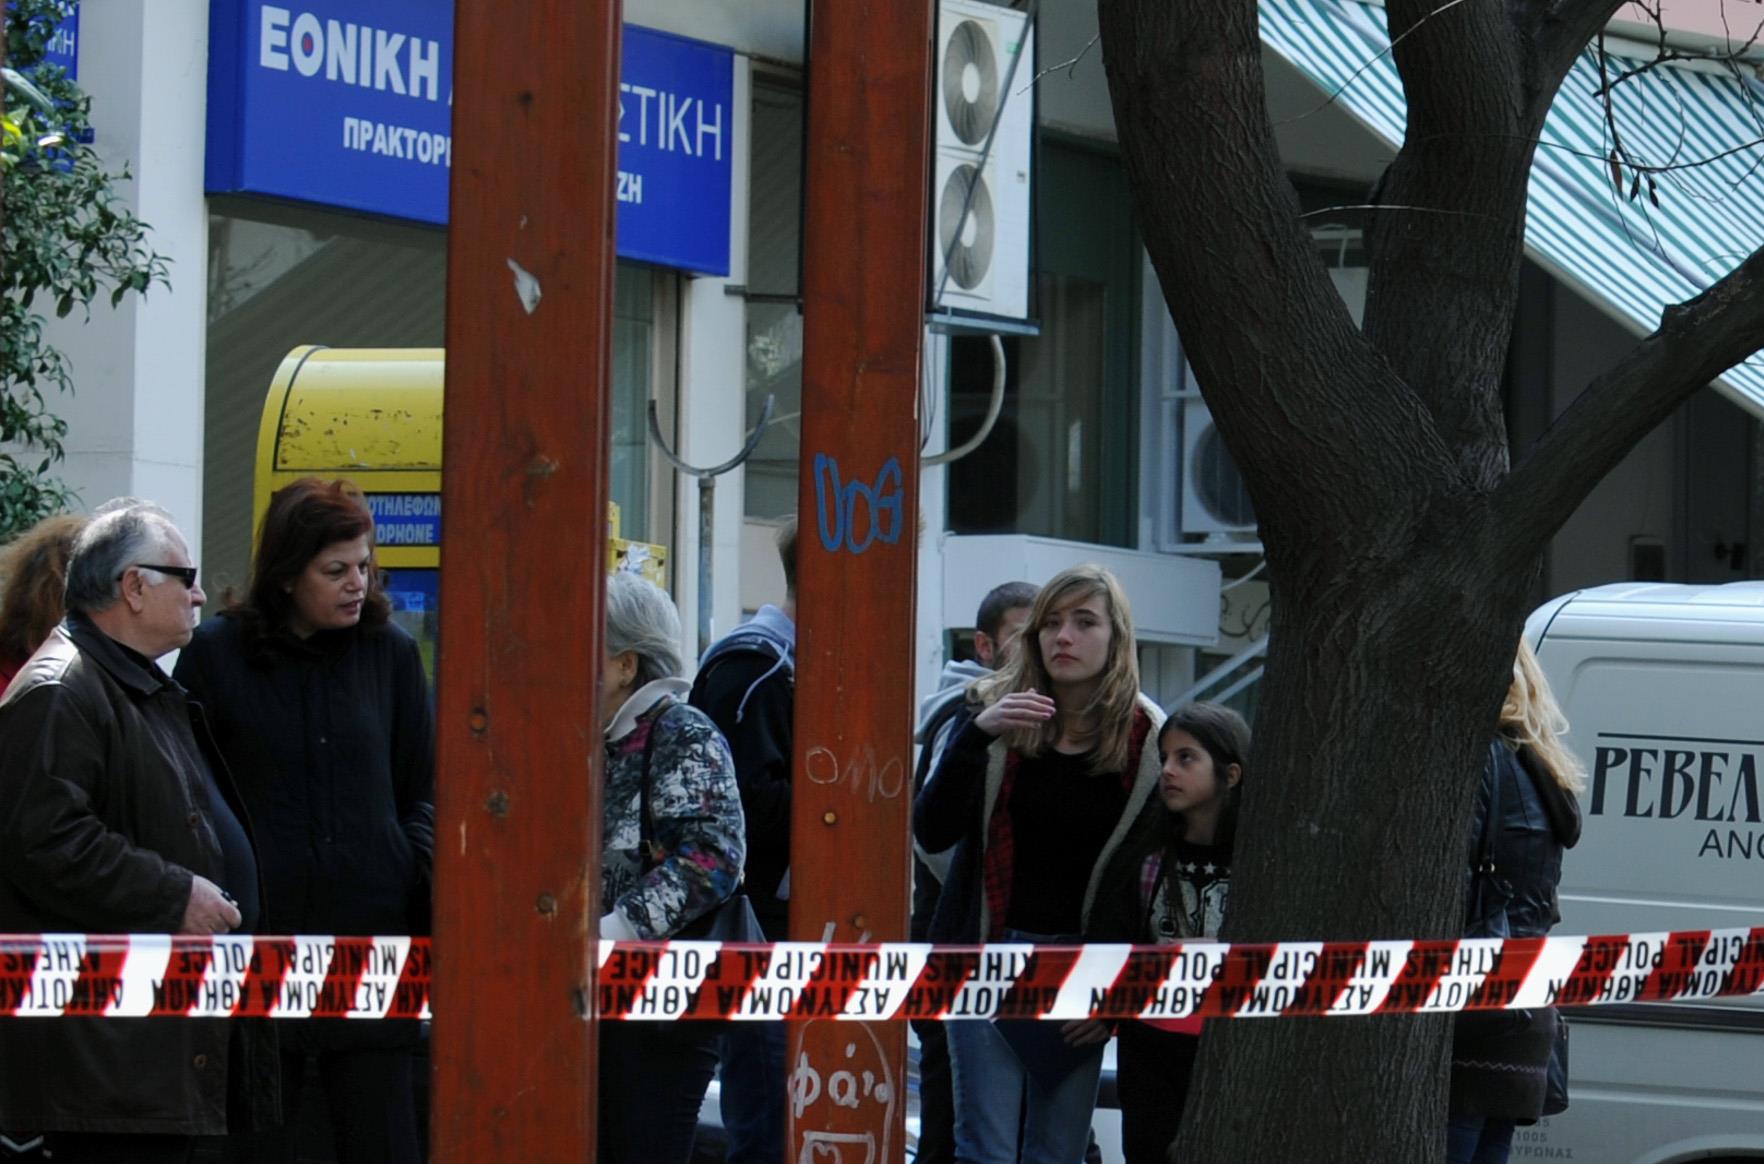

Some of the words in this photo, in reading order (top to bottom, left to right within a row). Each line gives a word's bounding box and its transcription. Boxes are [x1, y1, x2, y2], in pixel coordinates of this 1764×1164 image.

[617, 82, 722, 161] ΣΤΙΚΗ
[599, 985, 702, 1016] ΑΘΗΝΩ
[1514, 1145, 1575, 1160] ΥΡΩΝΑΣ
